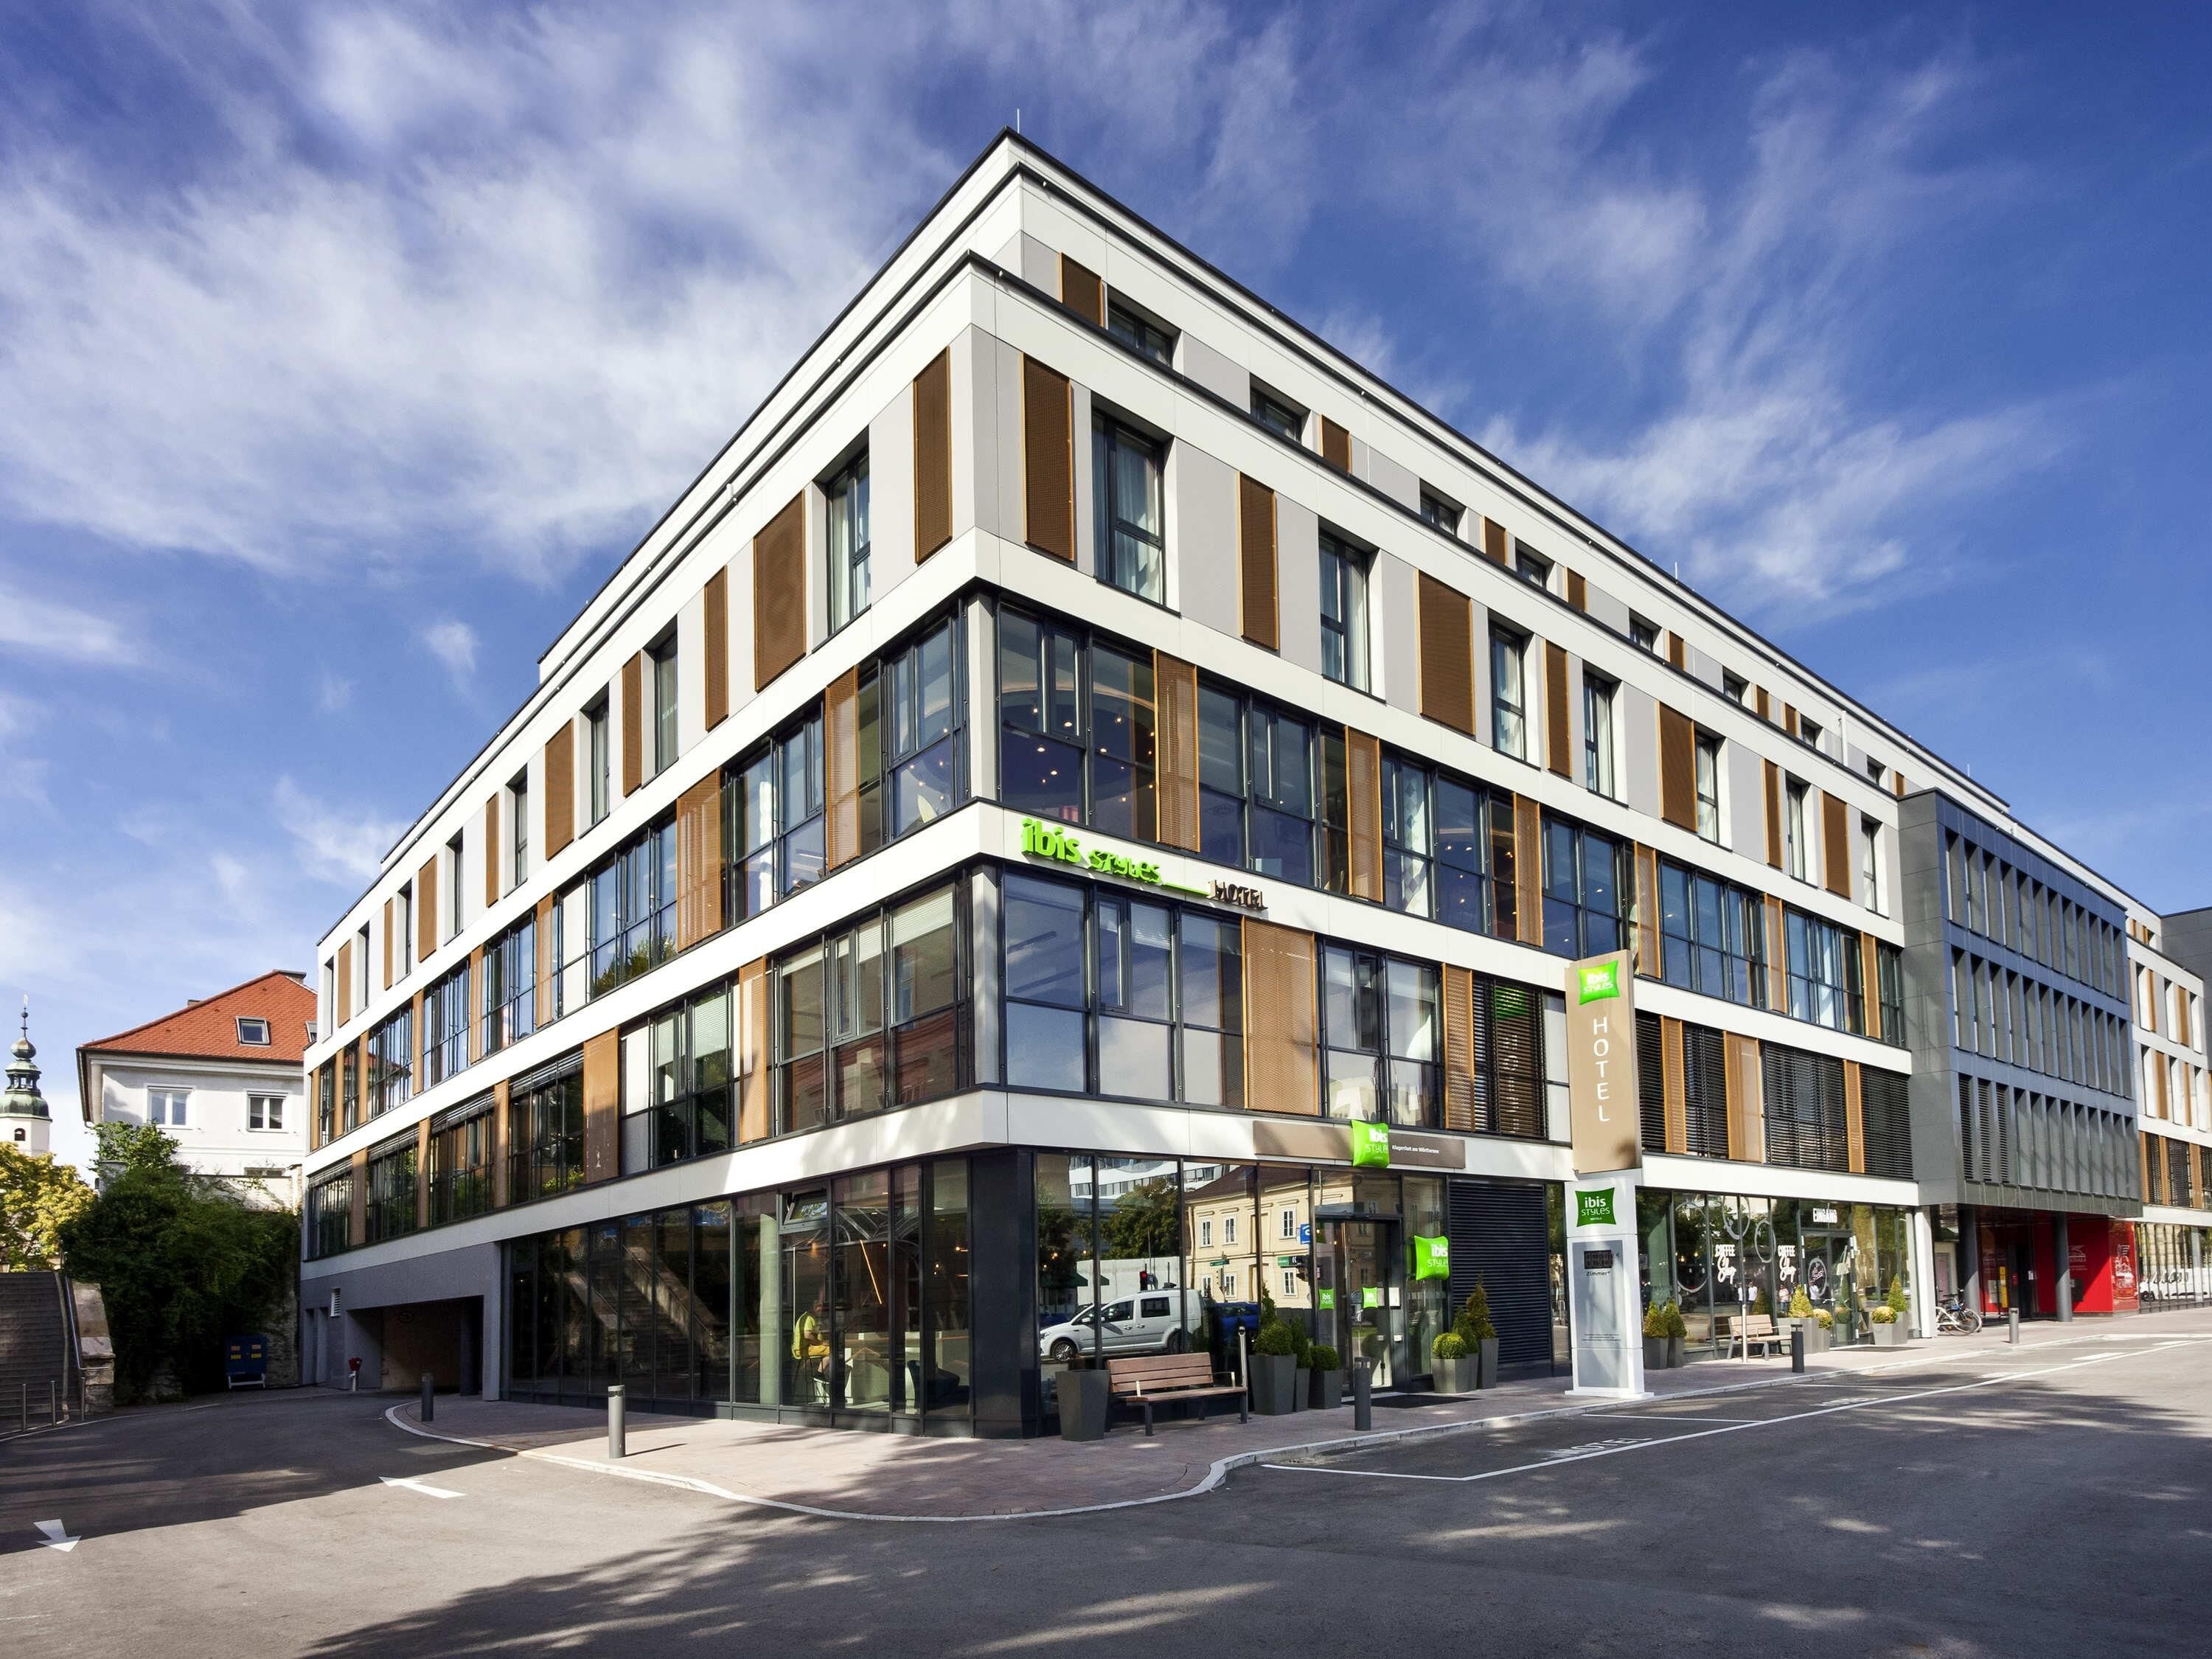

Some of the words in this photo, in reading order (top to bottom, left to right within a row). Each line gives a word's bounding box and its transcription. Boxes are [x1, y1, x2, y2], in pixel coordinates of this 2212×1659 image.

[1022, 818, 1083, 863] ibis
[1208, 880, 1269, 910] HOTEL
[1586, 972, 1609, 985] ibis
[1593, 1016, 1610, 1121] HOTEL
[1368, 1127, 1388, 1142] ibis
[1585, 1196, 1606, 1208] ibis
[1714, 1244, 1736, 1257] COFFEE
[1778, 1245, 1795, 1257] COFFEE
